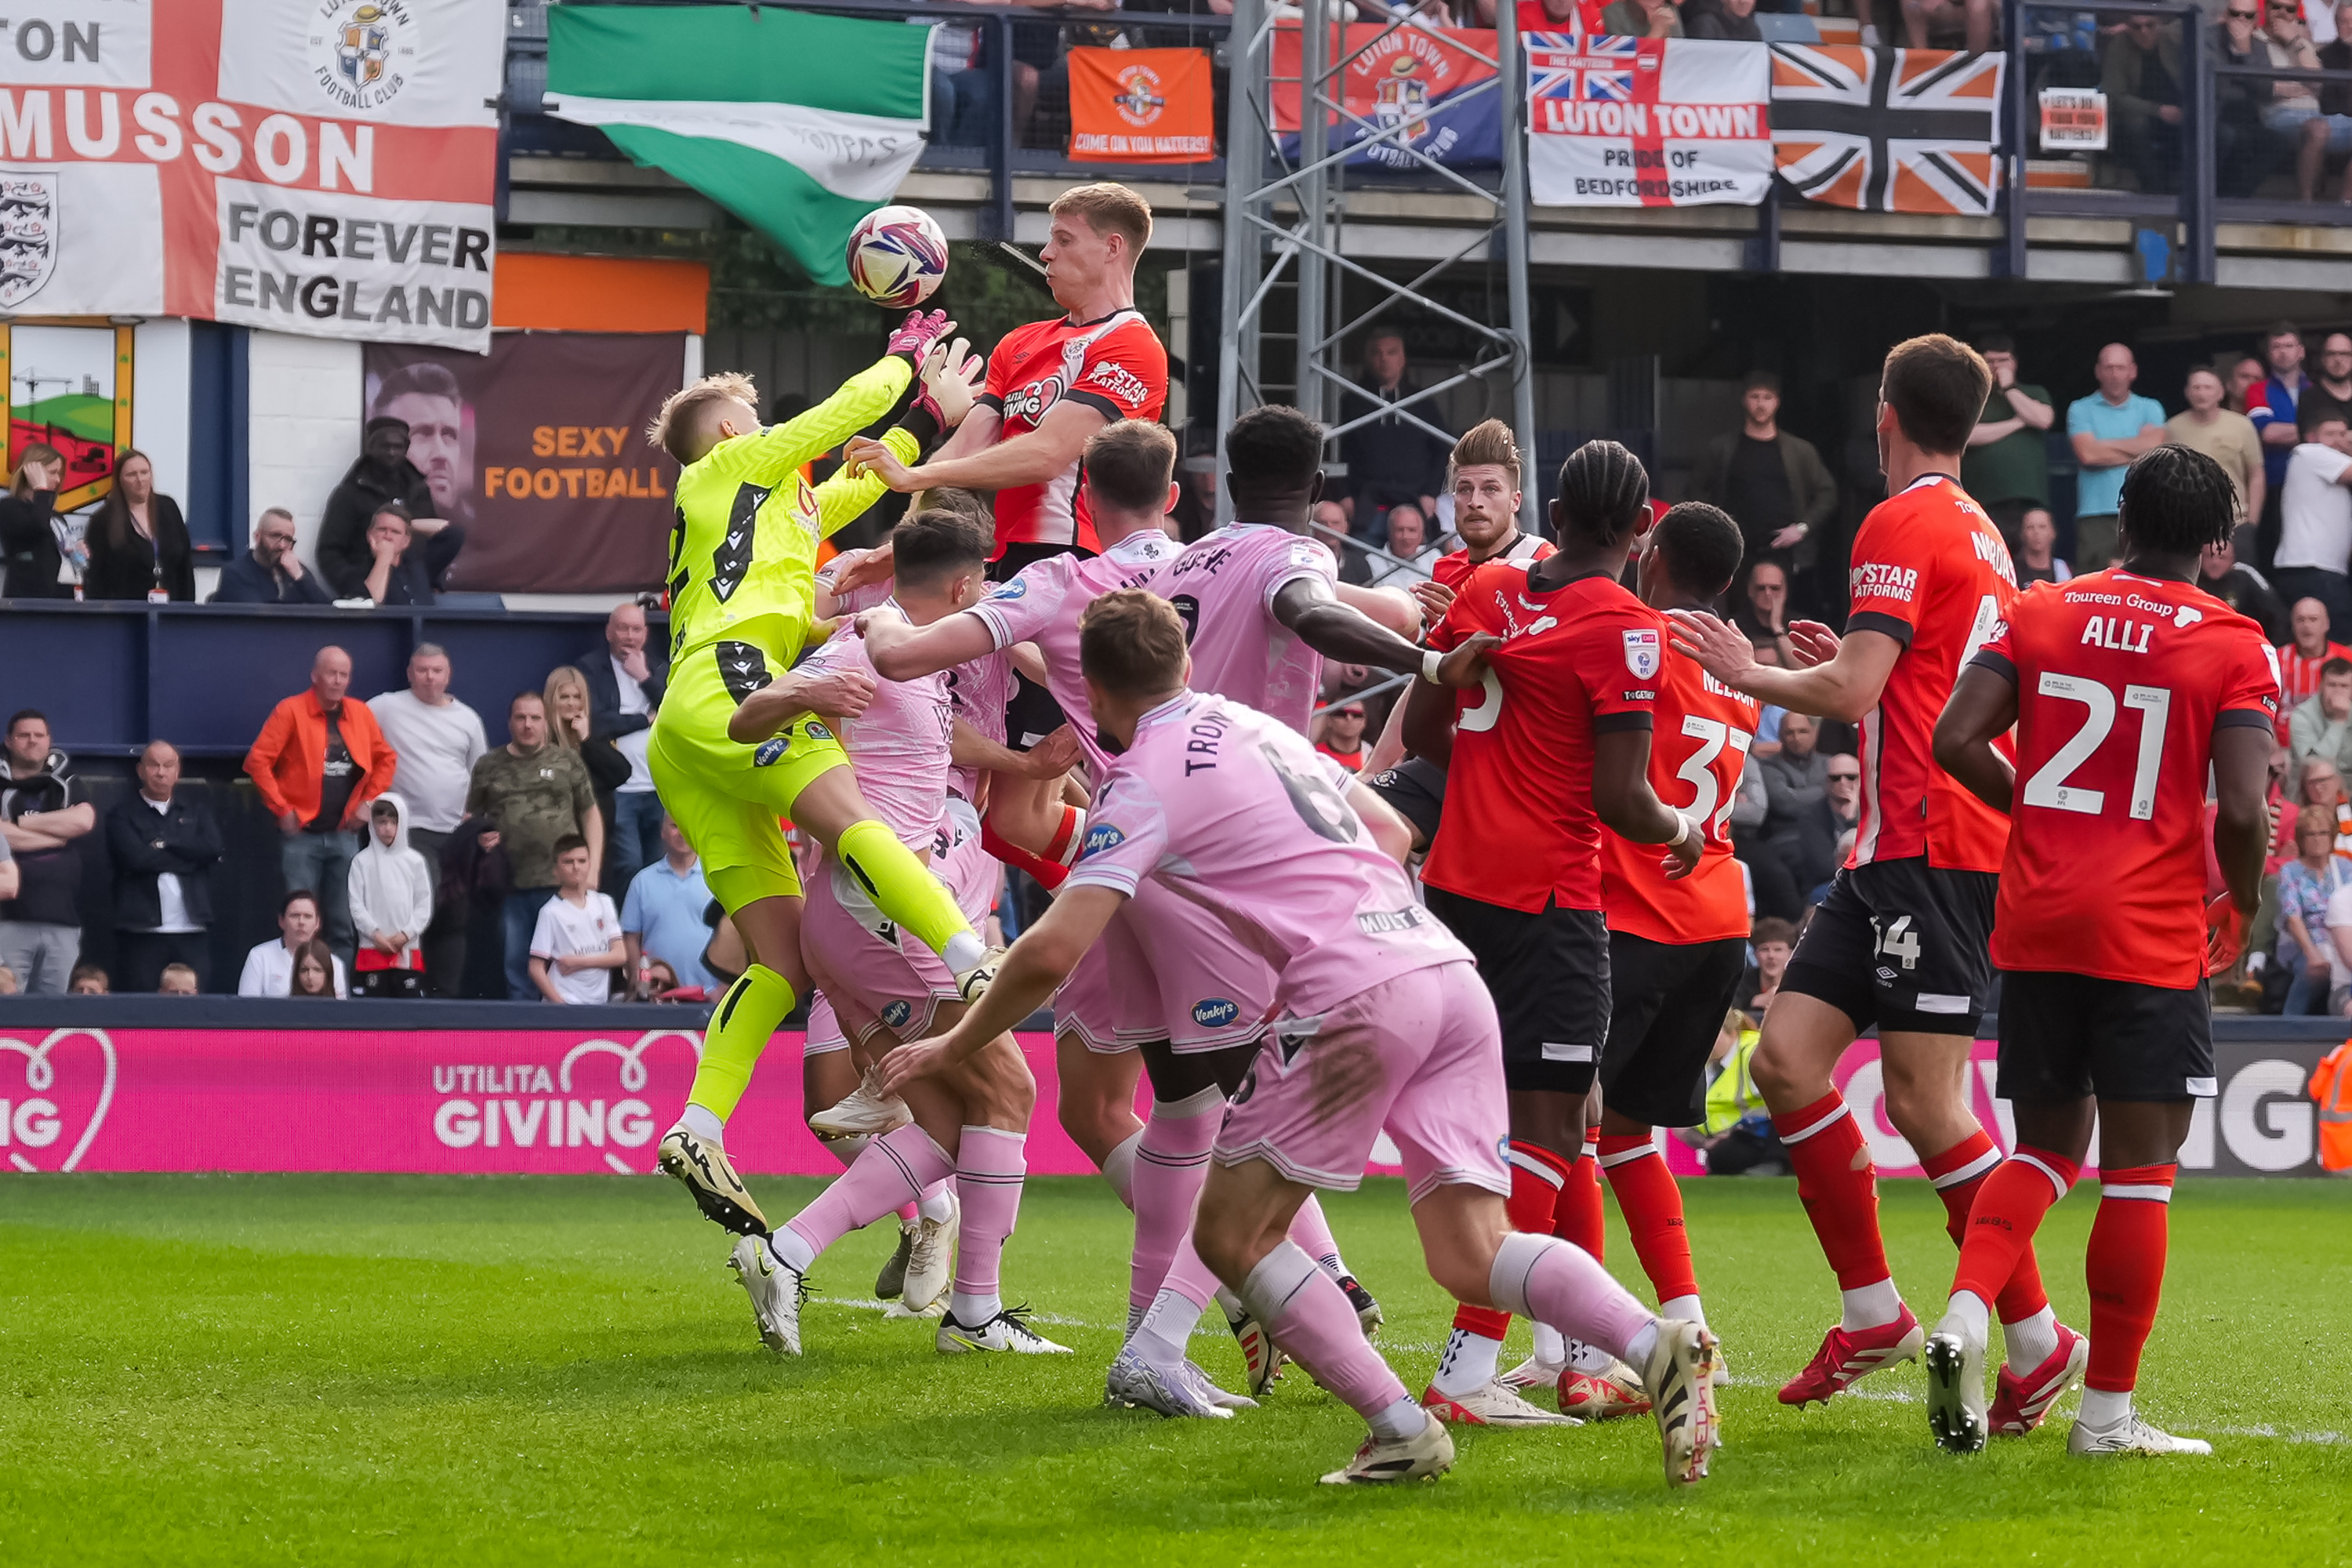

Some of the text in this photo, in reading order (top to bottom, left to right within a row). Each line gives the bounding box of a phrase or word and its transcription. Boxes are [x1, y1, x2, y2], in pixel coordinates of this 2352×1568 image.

[1352, 32, 1449, 79] LUTON TOWN
[1548, 55, 1567, 67] THE
[314, 65, 404, 109] FOOTBALL CLUB
[1544, 100, 1759, 138] LUTON TOWN
[1075, 133, 1109, 151] COME
[1110, 135, 1129, 151] ON
[1129, 136, 1154, 152] YOU
[1603, 147, 1699, 169] PRIDE OF
[1573, 177, 1738, 197] BEDFORDSHIRE
[228, 201, 490, 273] FOREVER
[223, 264, 489, 330] ENGLAND
[1114, 369, 1149, 402] STAR
[1004, 395, 1041, 419] IVING
[532, 425, 630, 458] SEXY
[485, 466, 667, 500] FOOTBALL
[1866, 561, 1918, 590] STAR
[1855, 583, 1913, 602] ATFORMS
[2063, 591, 2173, 617] Toureen Group
[2081, 615, 2154, 654] ALLI
[756, 739, 783, 767] Venky's
[2022, 670, 2172, 822] 21
[1258, 740, 1359, 845] 6
[1195, 1002, 1234, 1022] Venky's
[433, 1065, 554, 1093] UTILITA
[434, 1099, 655, 1148] GIVING
